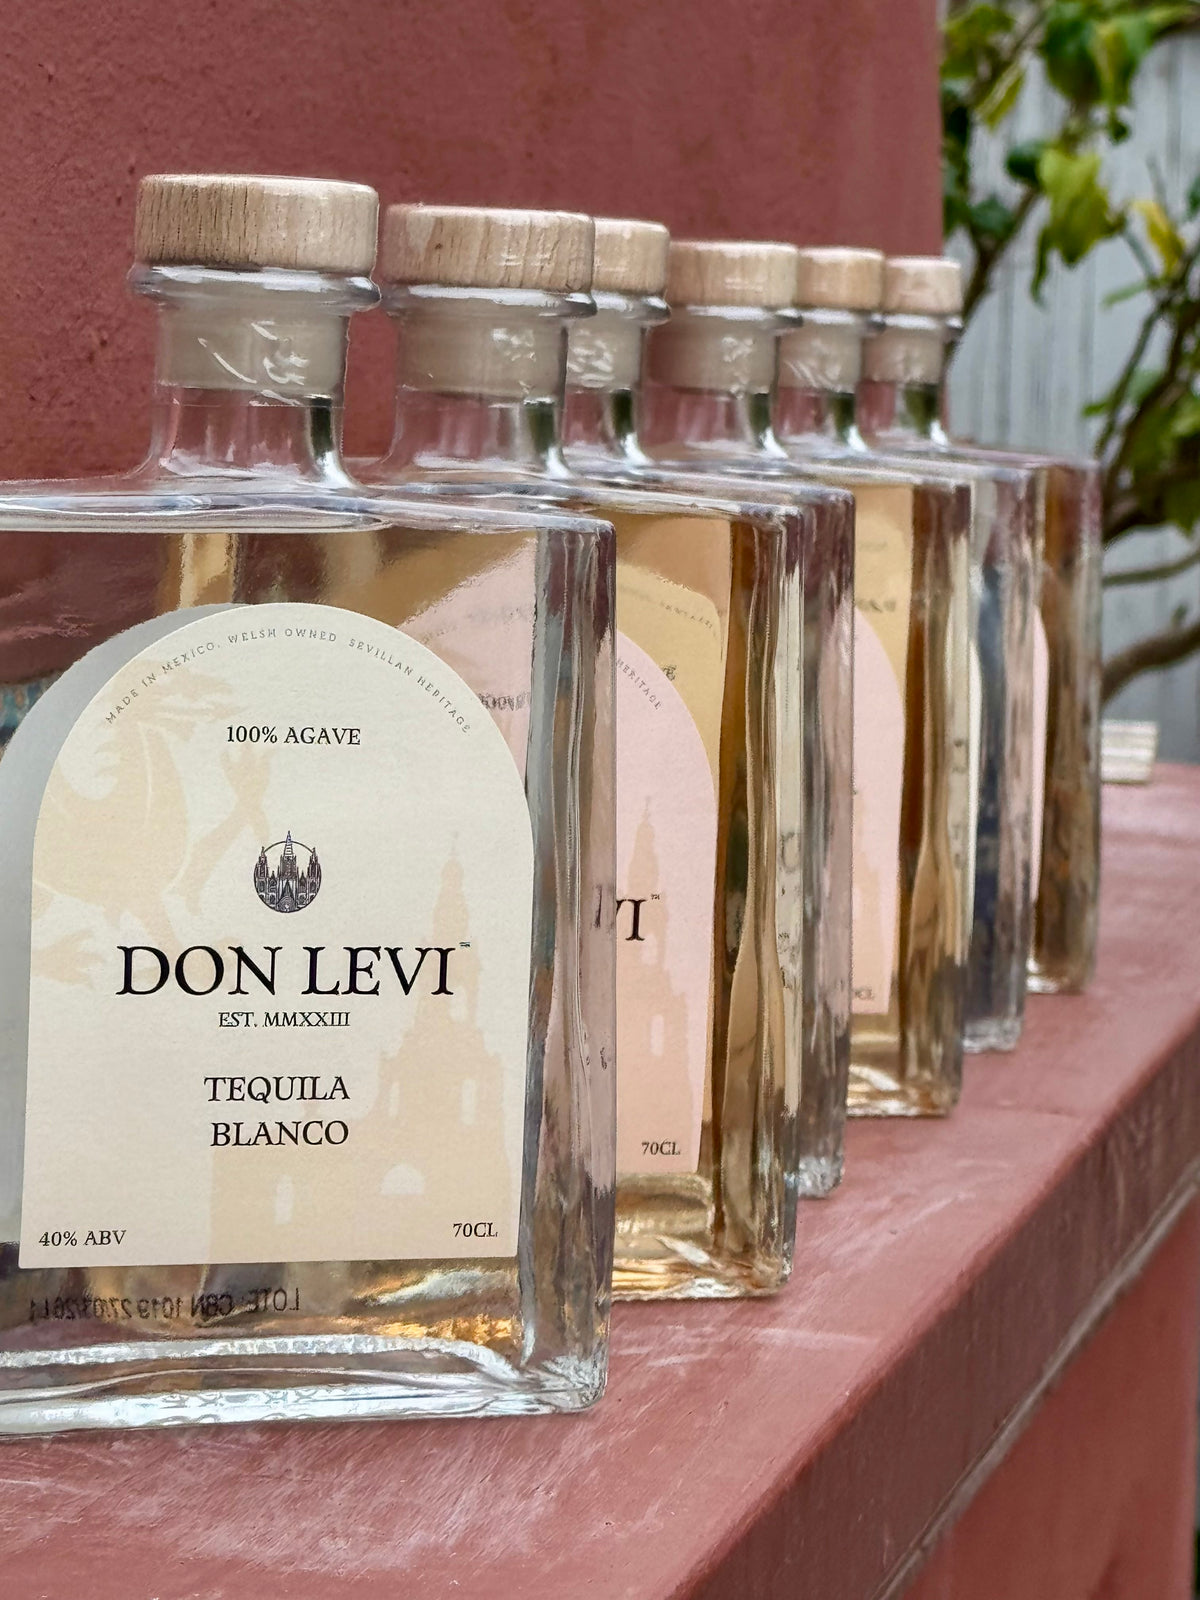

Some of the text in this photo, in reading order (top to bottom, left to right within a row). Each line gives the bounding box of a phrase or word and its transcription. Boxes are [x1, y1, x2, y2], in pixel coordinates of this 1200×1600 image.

[105, 688, 139, 724] MADE
[141, 673, 156, 687] IN
[228, 628, 276, 643] WELSH
[284, 628, 337, 642] OWNED
[348, 638, 413, 676] SEVILLAN
[417, 676, 471, 733] HERITAGE
[226, 725, 361, 745] 100% AGAVE
[116, 945, 456, 996] DON LEVI
[218, 1012, 351, 1028] EST. MMXXIII
[203, 1076, 351, 1104] TEQUILA
[210, 1120, 349, 1147] BLANCO
[641, 1140, 681, 1155] 70CL
[38, 1229, 127, 1247] 40% ABV
[452, 1222, 499, 1238] 70CL
